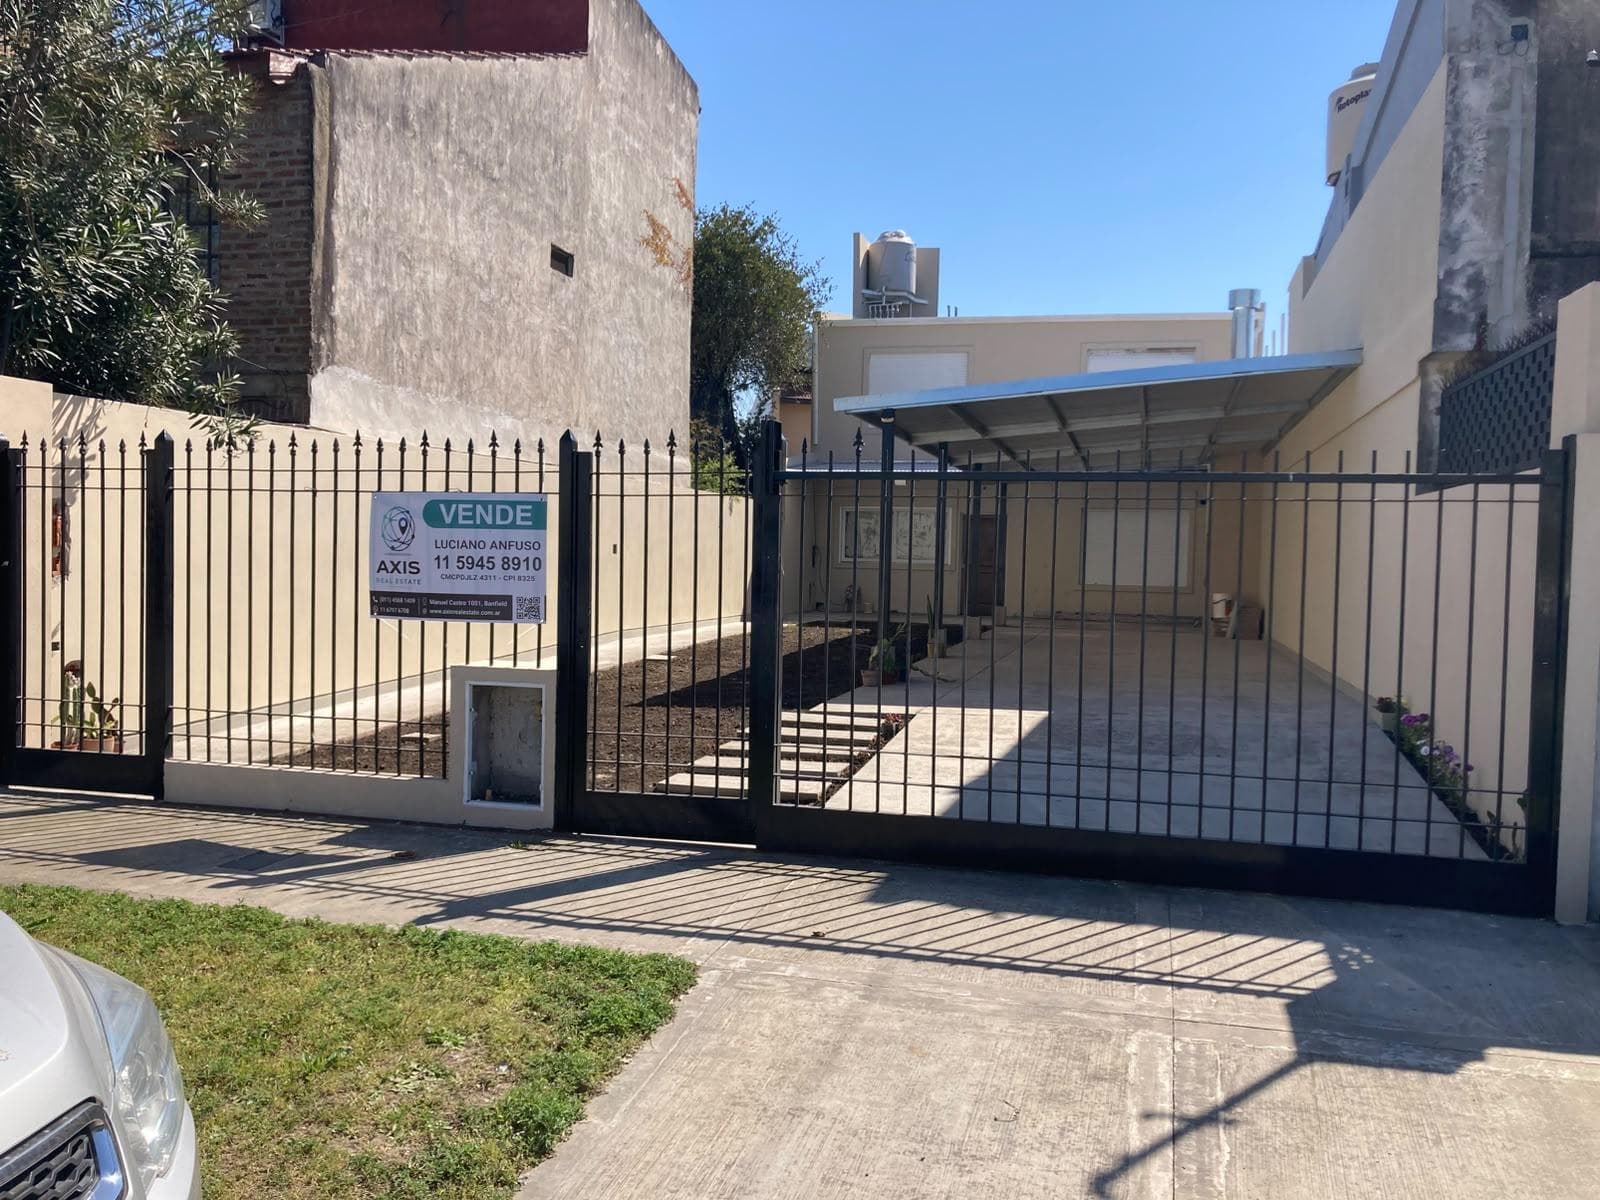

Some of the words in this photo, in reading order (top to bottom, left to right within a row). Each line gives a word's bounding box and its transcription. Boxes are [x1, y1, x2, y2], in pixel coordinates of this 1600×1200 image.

[439, 503, 533, 526] VENDE
[434, 539, 486, 550] LUCIANO
[489, 540, 541, 551] ANFUSO
[376, 560, 421, 575] AXIS
[434, 555, 449, 570] 11
[456, 555, 496, 571] 5945
[501, 556, 542, 572] 8910
